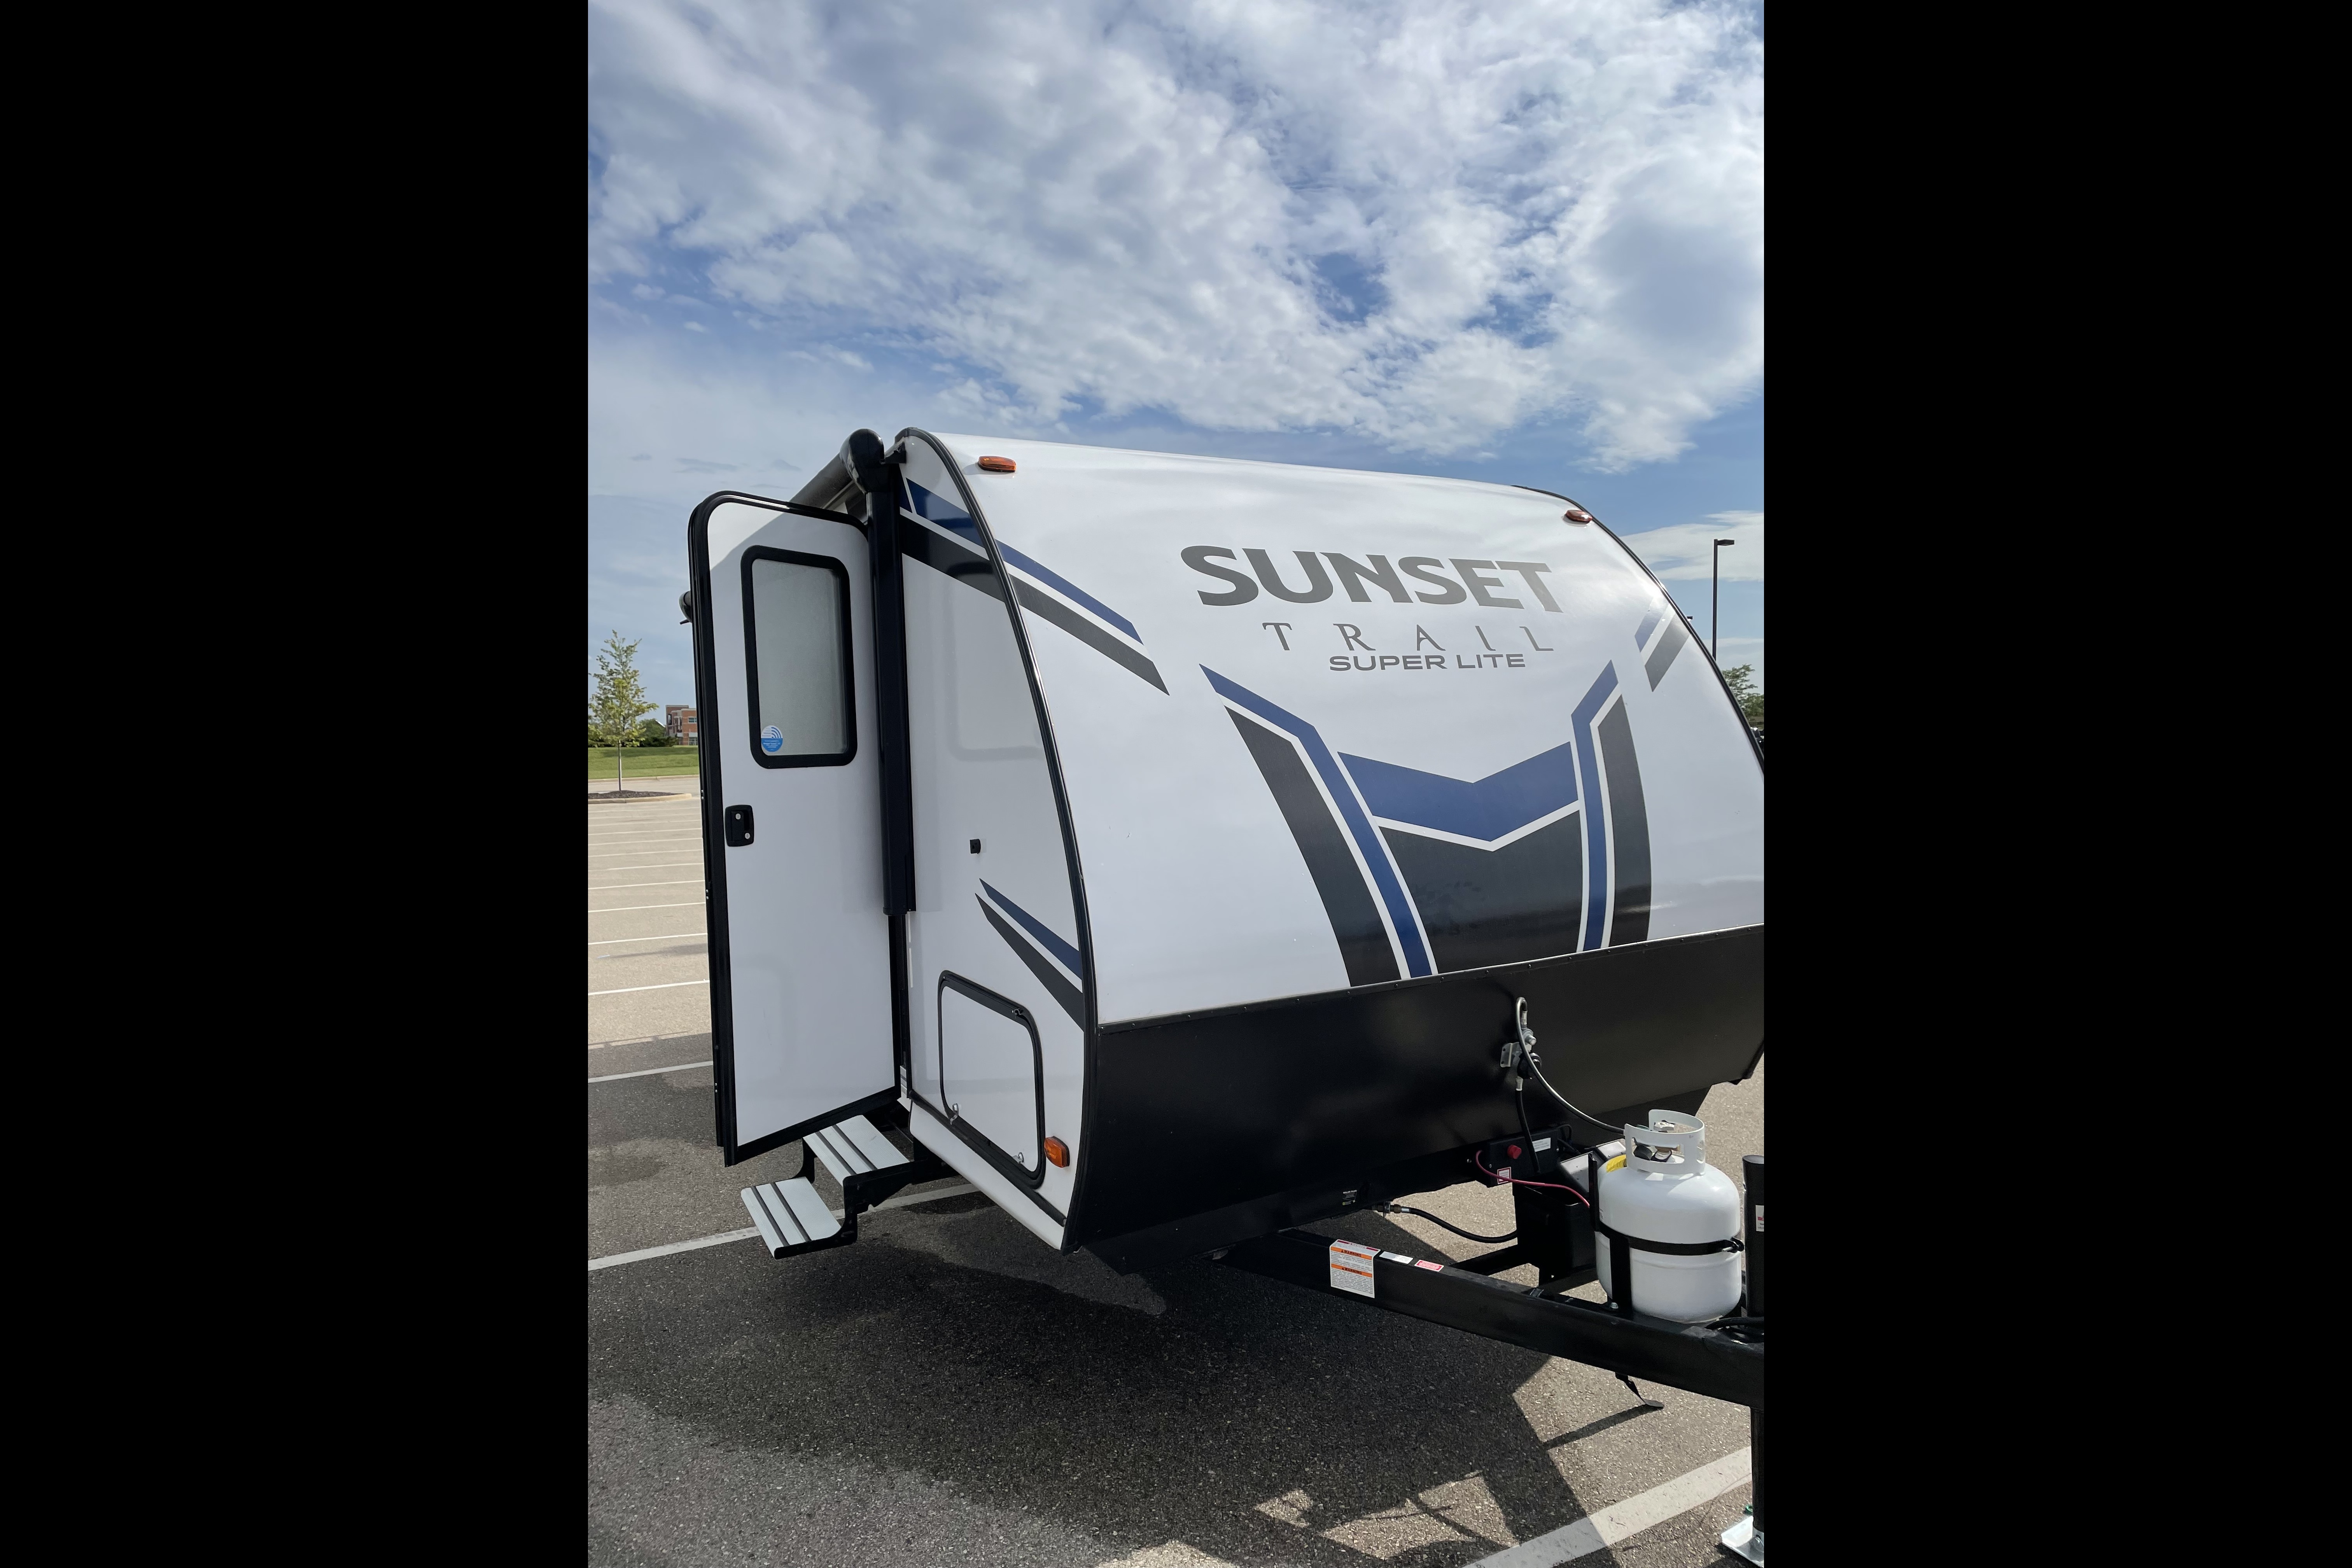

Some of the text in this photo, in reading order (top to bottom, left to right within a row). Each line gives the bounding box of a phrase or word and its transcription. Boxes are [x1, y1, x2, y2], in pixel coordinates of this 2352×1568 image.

[1181, 545, 1564, 613] SUNSET
[1262, 622, 1554, 651] TRAIL
[1329, 653, 1526, 671] SUPER LITE
